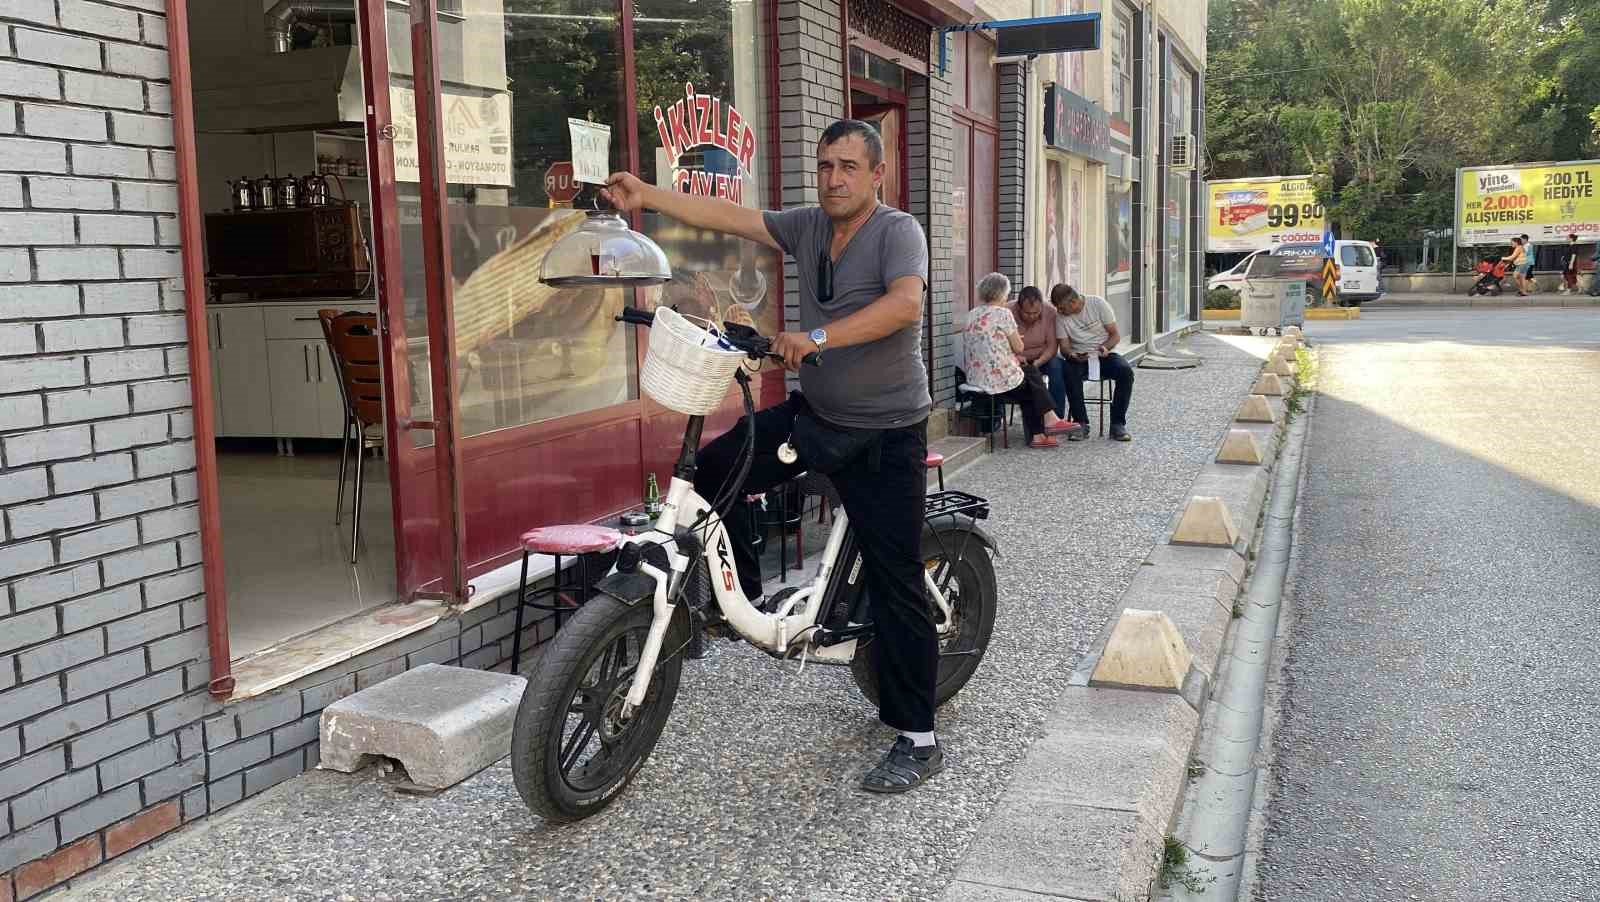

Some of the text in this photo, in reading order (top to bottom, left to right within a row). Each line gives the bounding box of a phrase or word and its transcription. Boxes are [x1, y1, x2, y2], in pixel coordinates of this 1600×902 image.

[654, 82, 757, 178] İKİZLER
[1480, 174, 1509, 189] yine
[1544, 171, 1593, 186] 200 TL
[1544, 185, 1593, 200] HEDİYE
[1466, 201, 1482, 209] HER
[1484, 194, 1528, 210] 2.000
[1465, 209, 1534, 225] ALIŞVERİŞE
